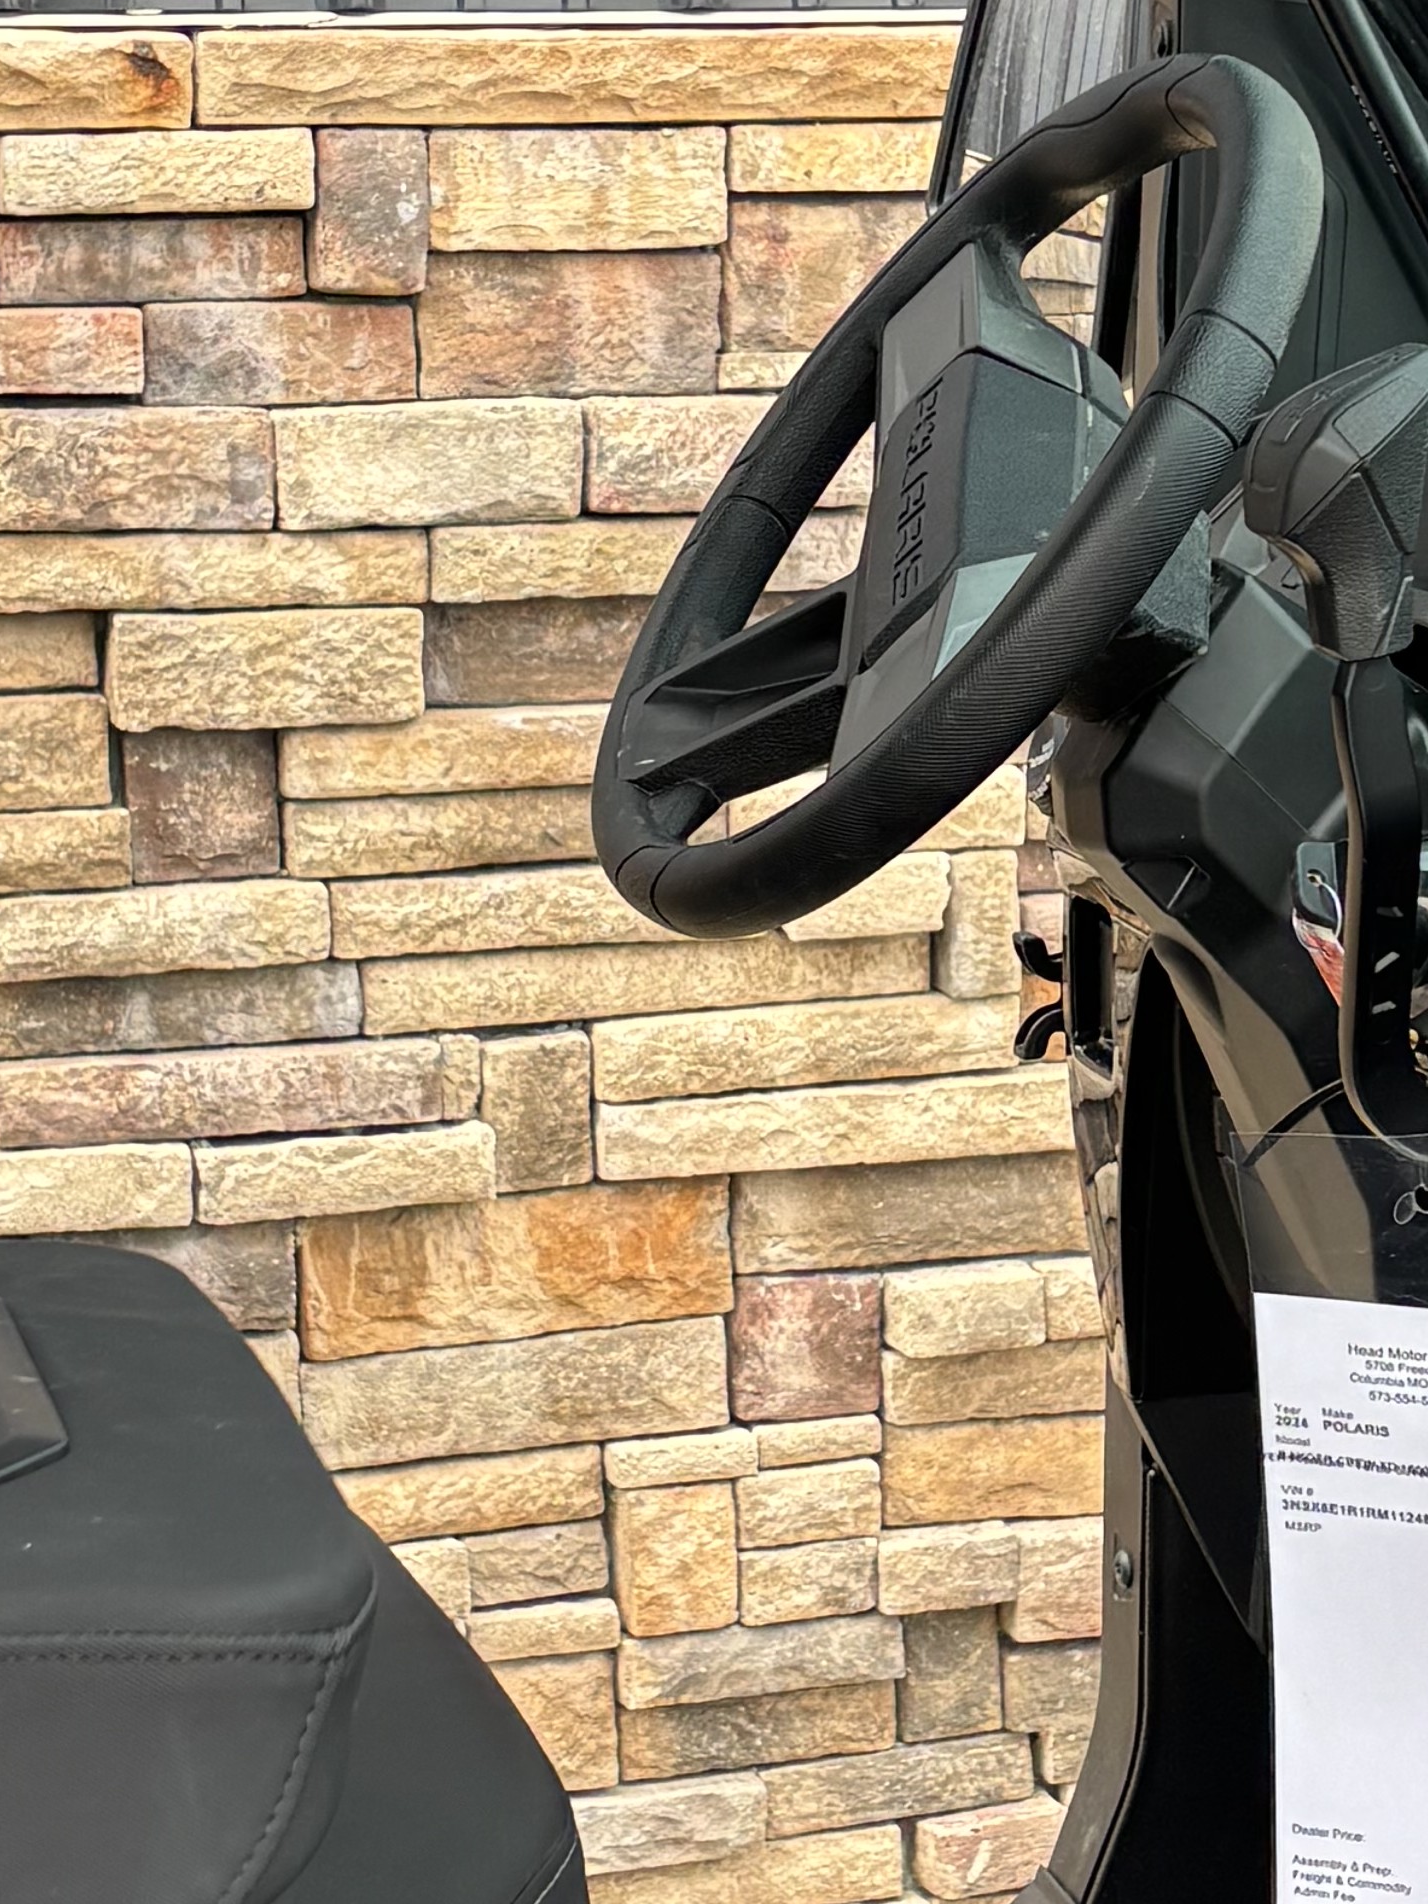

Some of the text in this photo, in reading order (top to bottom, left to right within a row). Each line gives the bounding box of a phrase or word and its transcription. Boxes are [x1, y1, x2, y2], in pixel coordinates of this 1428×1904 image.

[1347, 1342, 1384, 1358] Head
[1388, 1346, 1428, 1361] Motor
[1323, 1419, 1391, 1438] POLARIS
